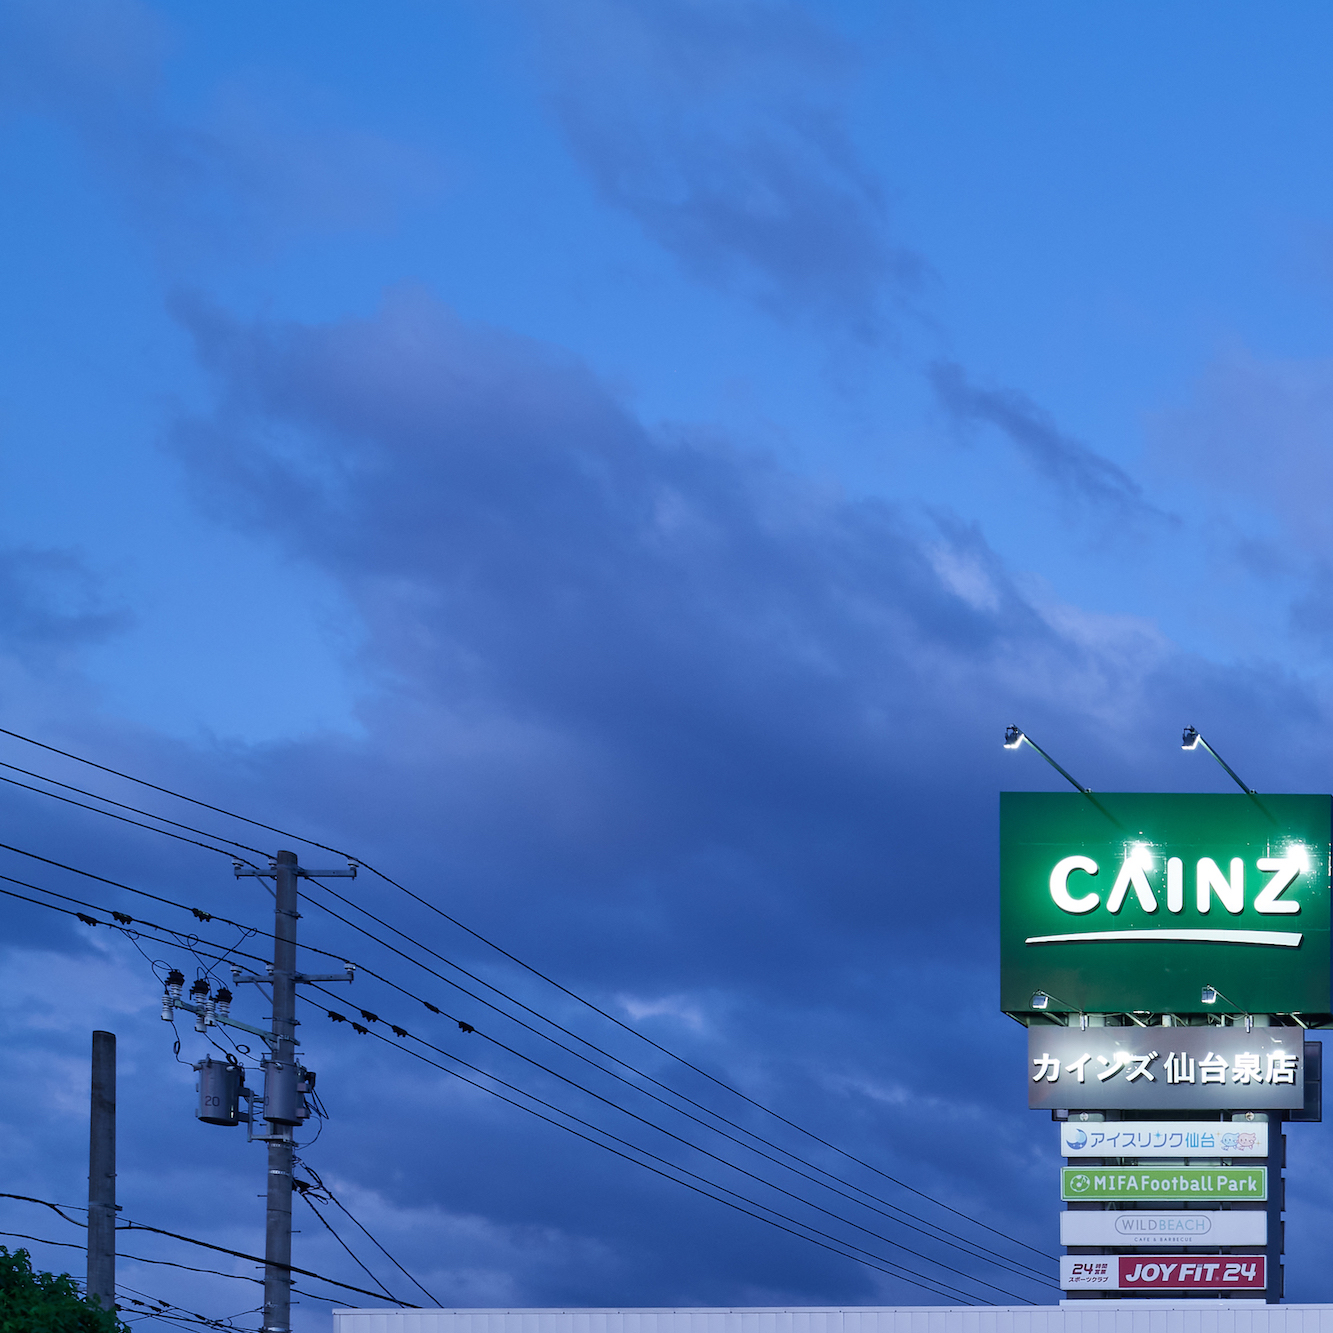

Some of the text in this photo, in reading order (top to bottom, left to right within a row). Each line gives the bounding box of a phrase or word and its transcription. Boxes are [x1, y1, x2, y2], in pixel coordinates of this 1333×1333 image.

[1049, 854, 1303, 914] CAINZ
[1032, 1050, 1298, 1084] カインズ 仙台泉店
[204, 1095, 220, 1107] 20
[1090, 1131, 1215, 1148] アイスリンク仙台
[1093, 1175, 1257, 1191] MIFA Football Park
